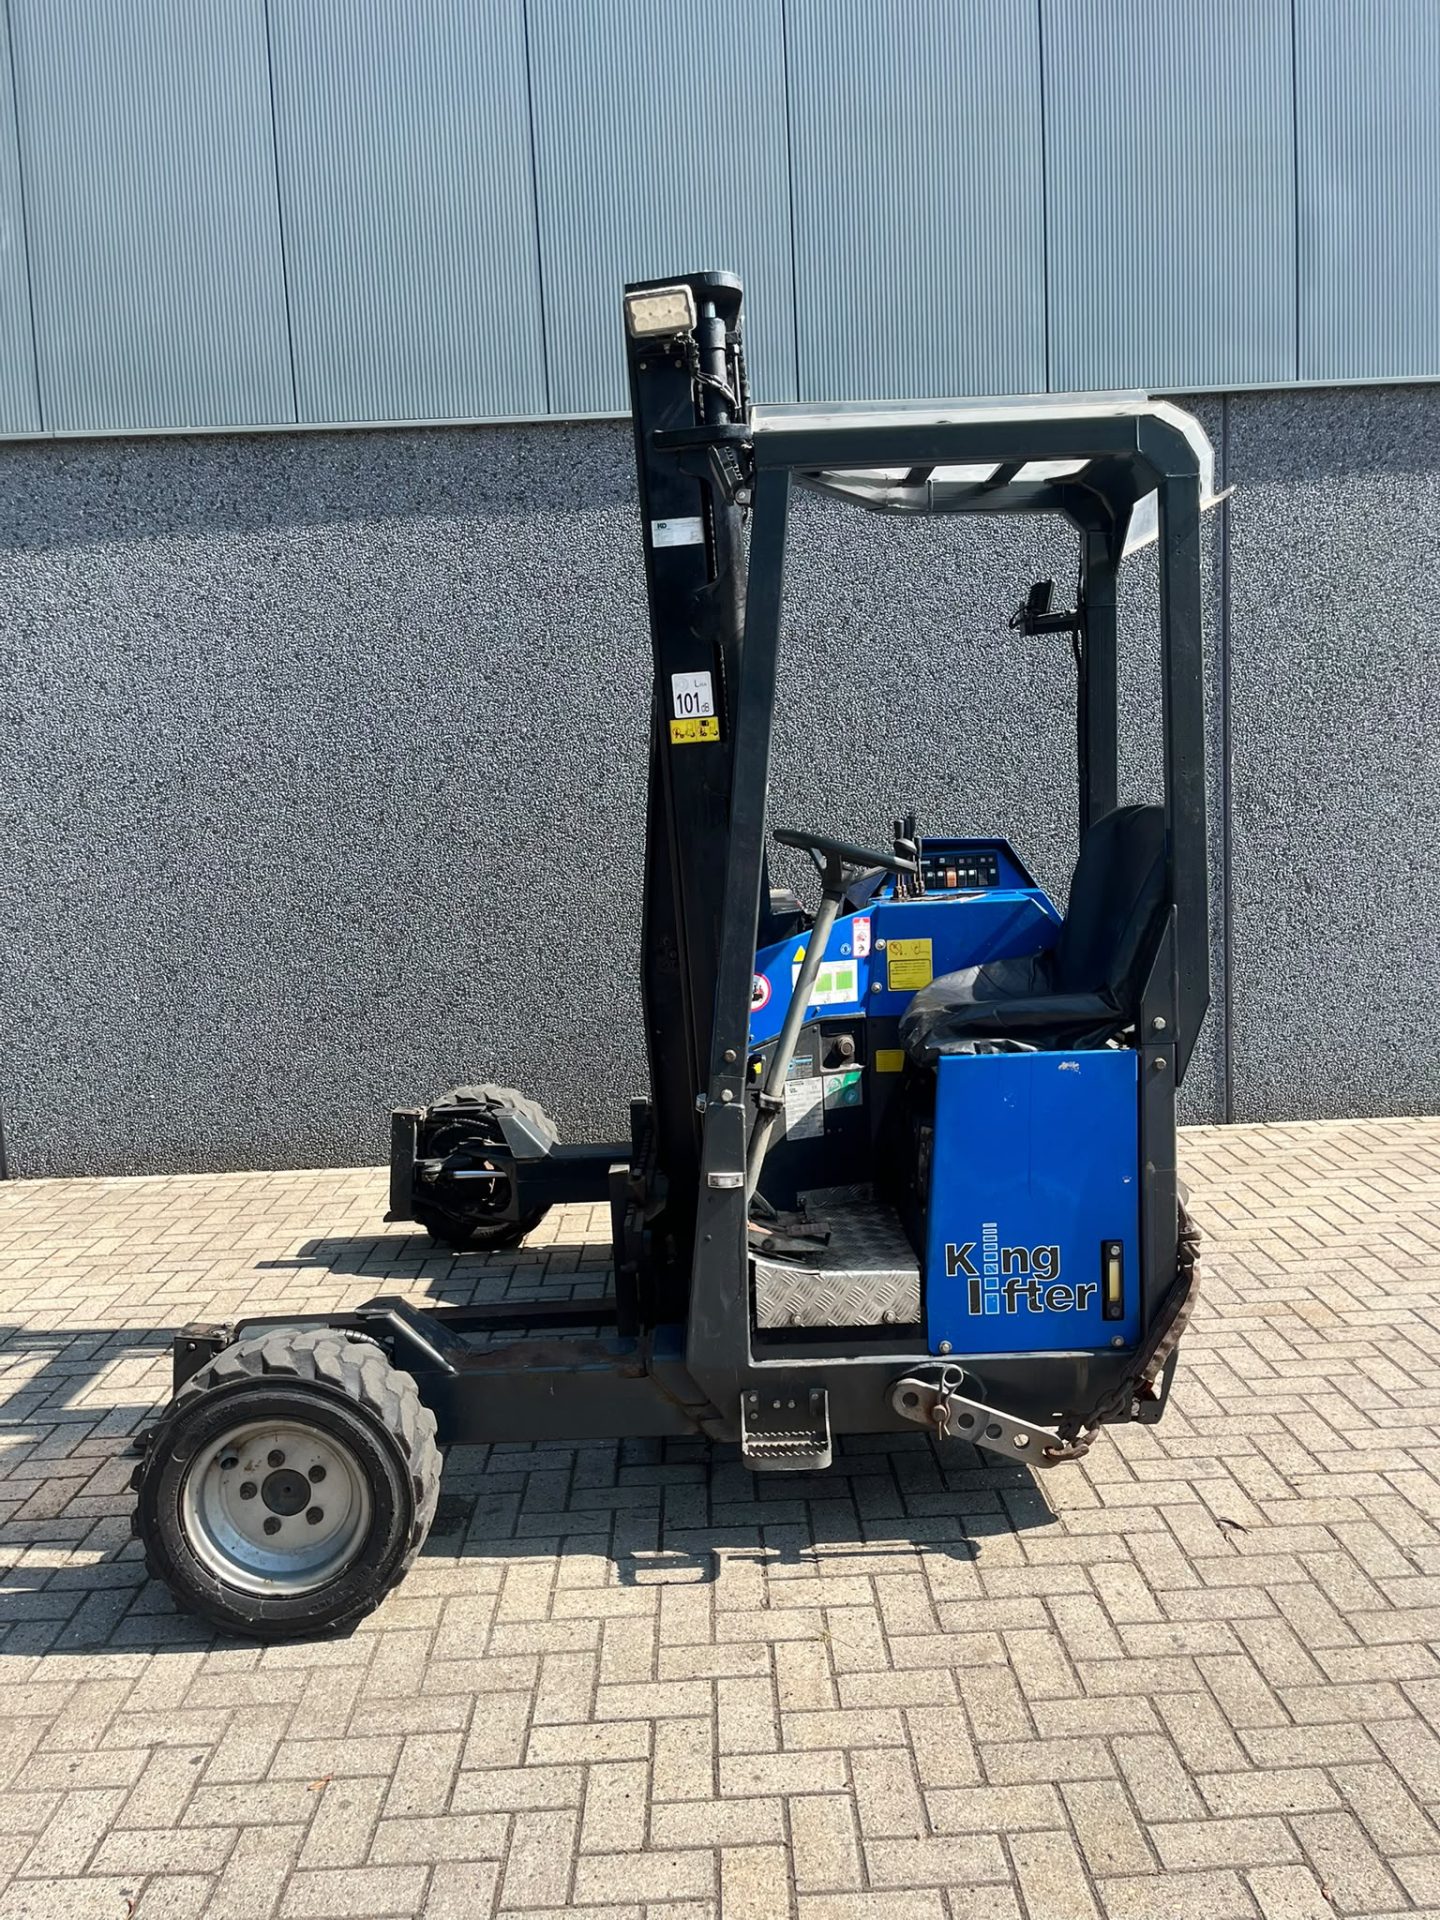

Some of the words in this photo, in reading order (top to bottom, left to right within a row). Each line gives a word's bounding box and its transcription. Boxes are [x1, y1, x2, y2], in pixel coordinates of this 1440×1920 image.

[677, 692, 700, 715] 101
[945, 1223, 1060, 1281] King
[968, 1278, 1097, 1315] lifter
